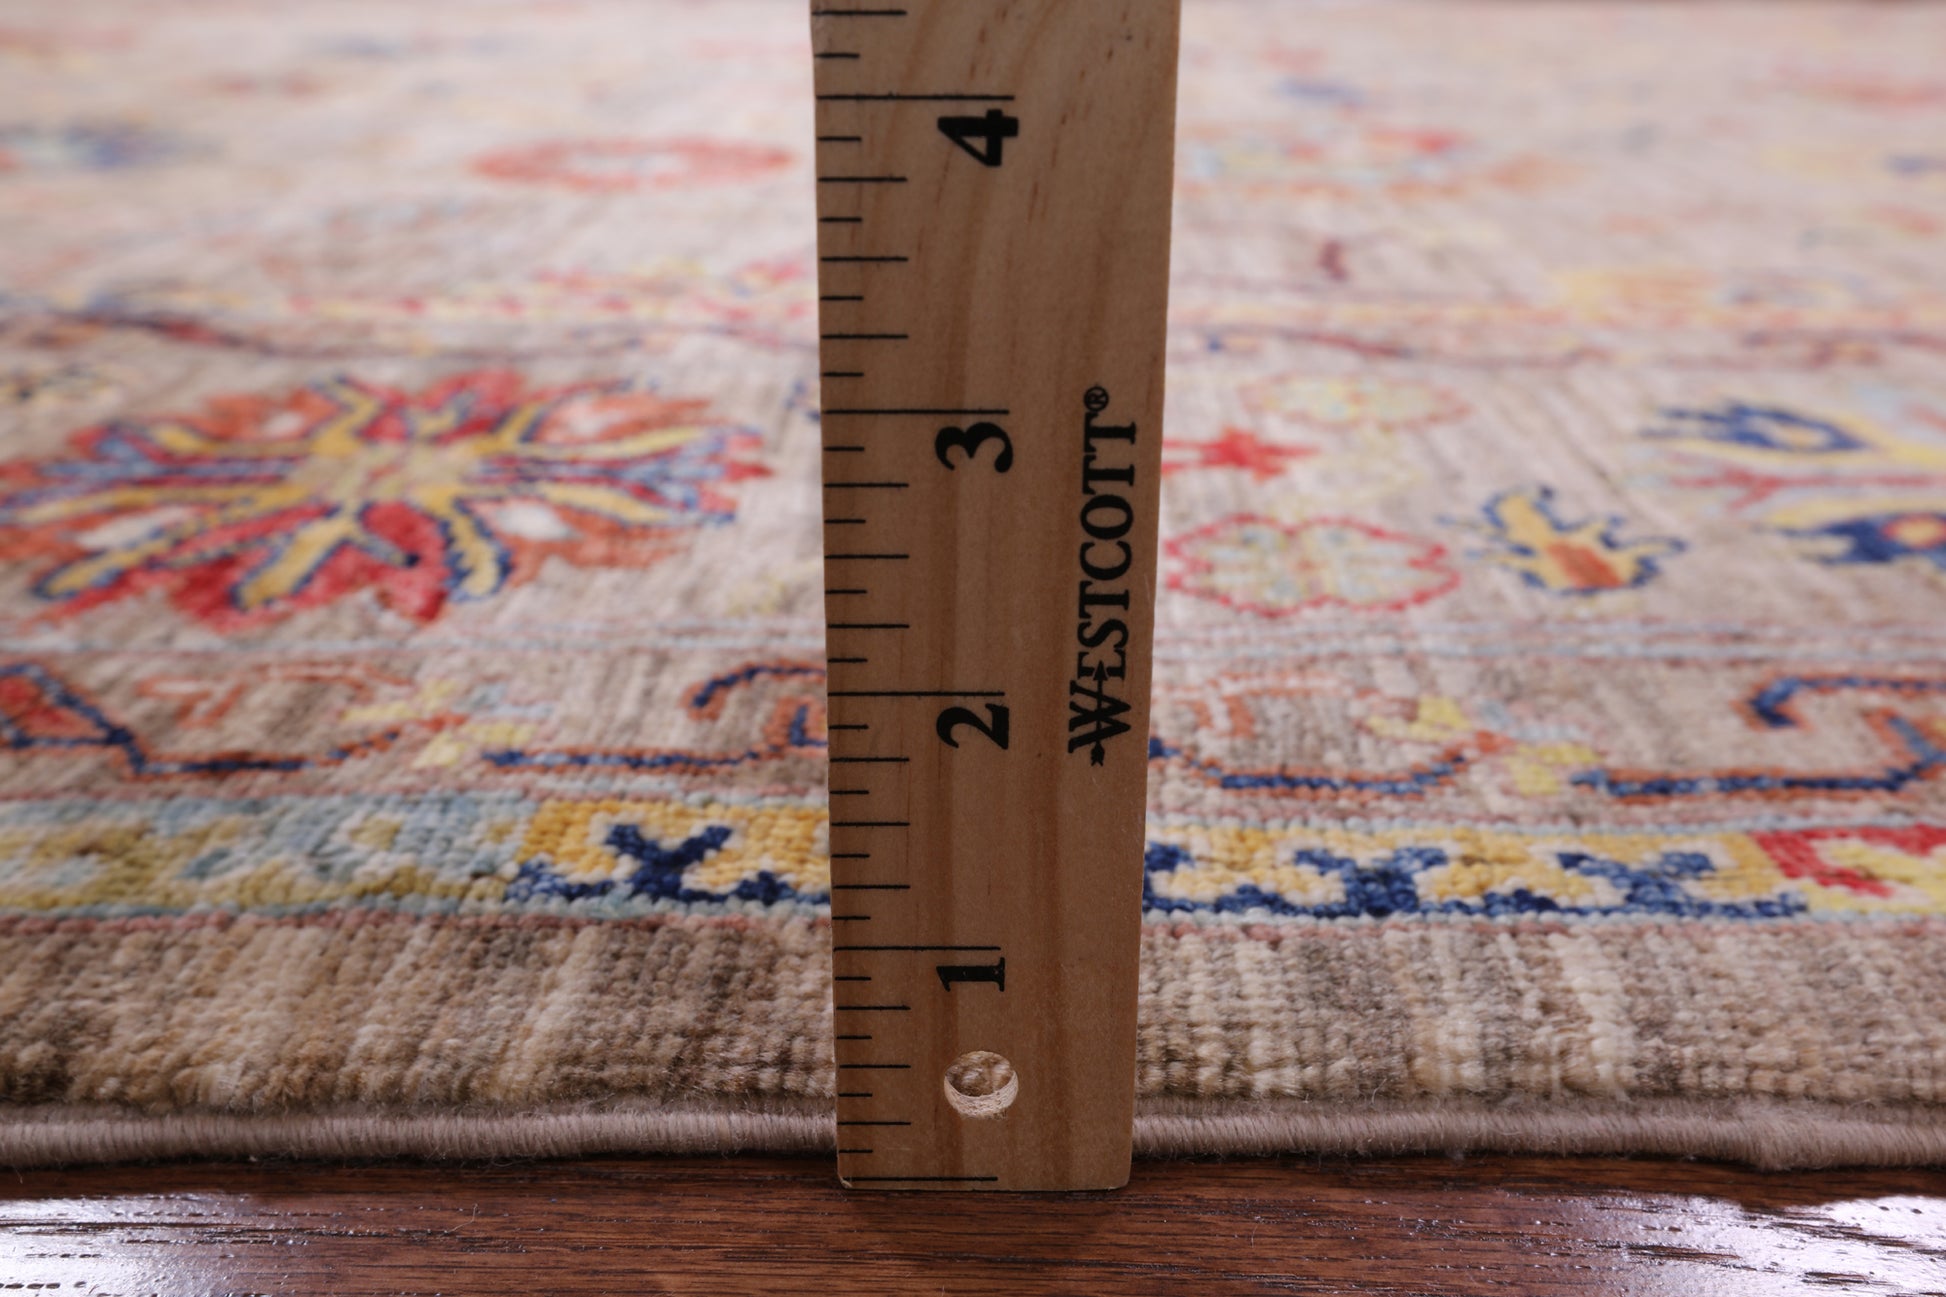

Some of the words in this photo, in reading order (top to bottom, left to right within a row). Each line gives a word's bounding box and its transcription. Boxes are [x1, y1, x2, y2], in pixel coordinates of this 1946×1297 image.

[937, 109, 1019, 167] 4
[934, 421, 1014, 474] 3
[935, 703, 1010, 751] 2
[936, 957, 1006, 992] 1
